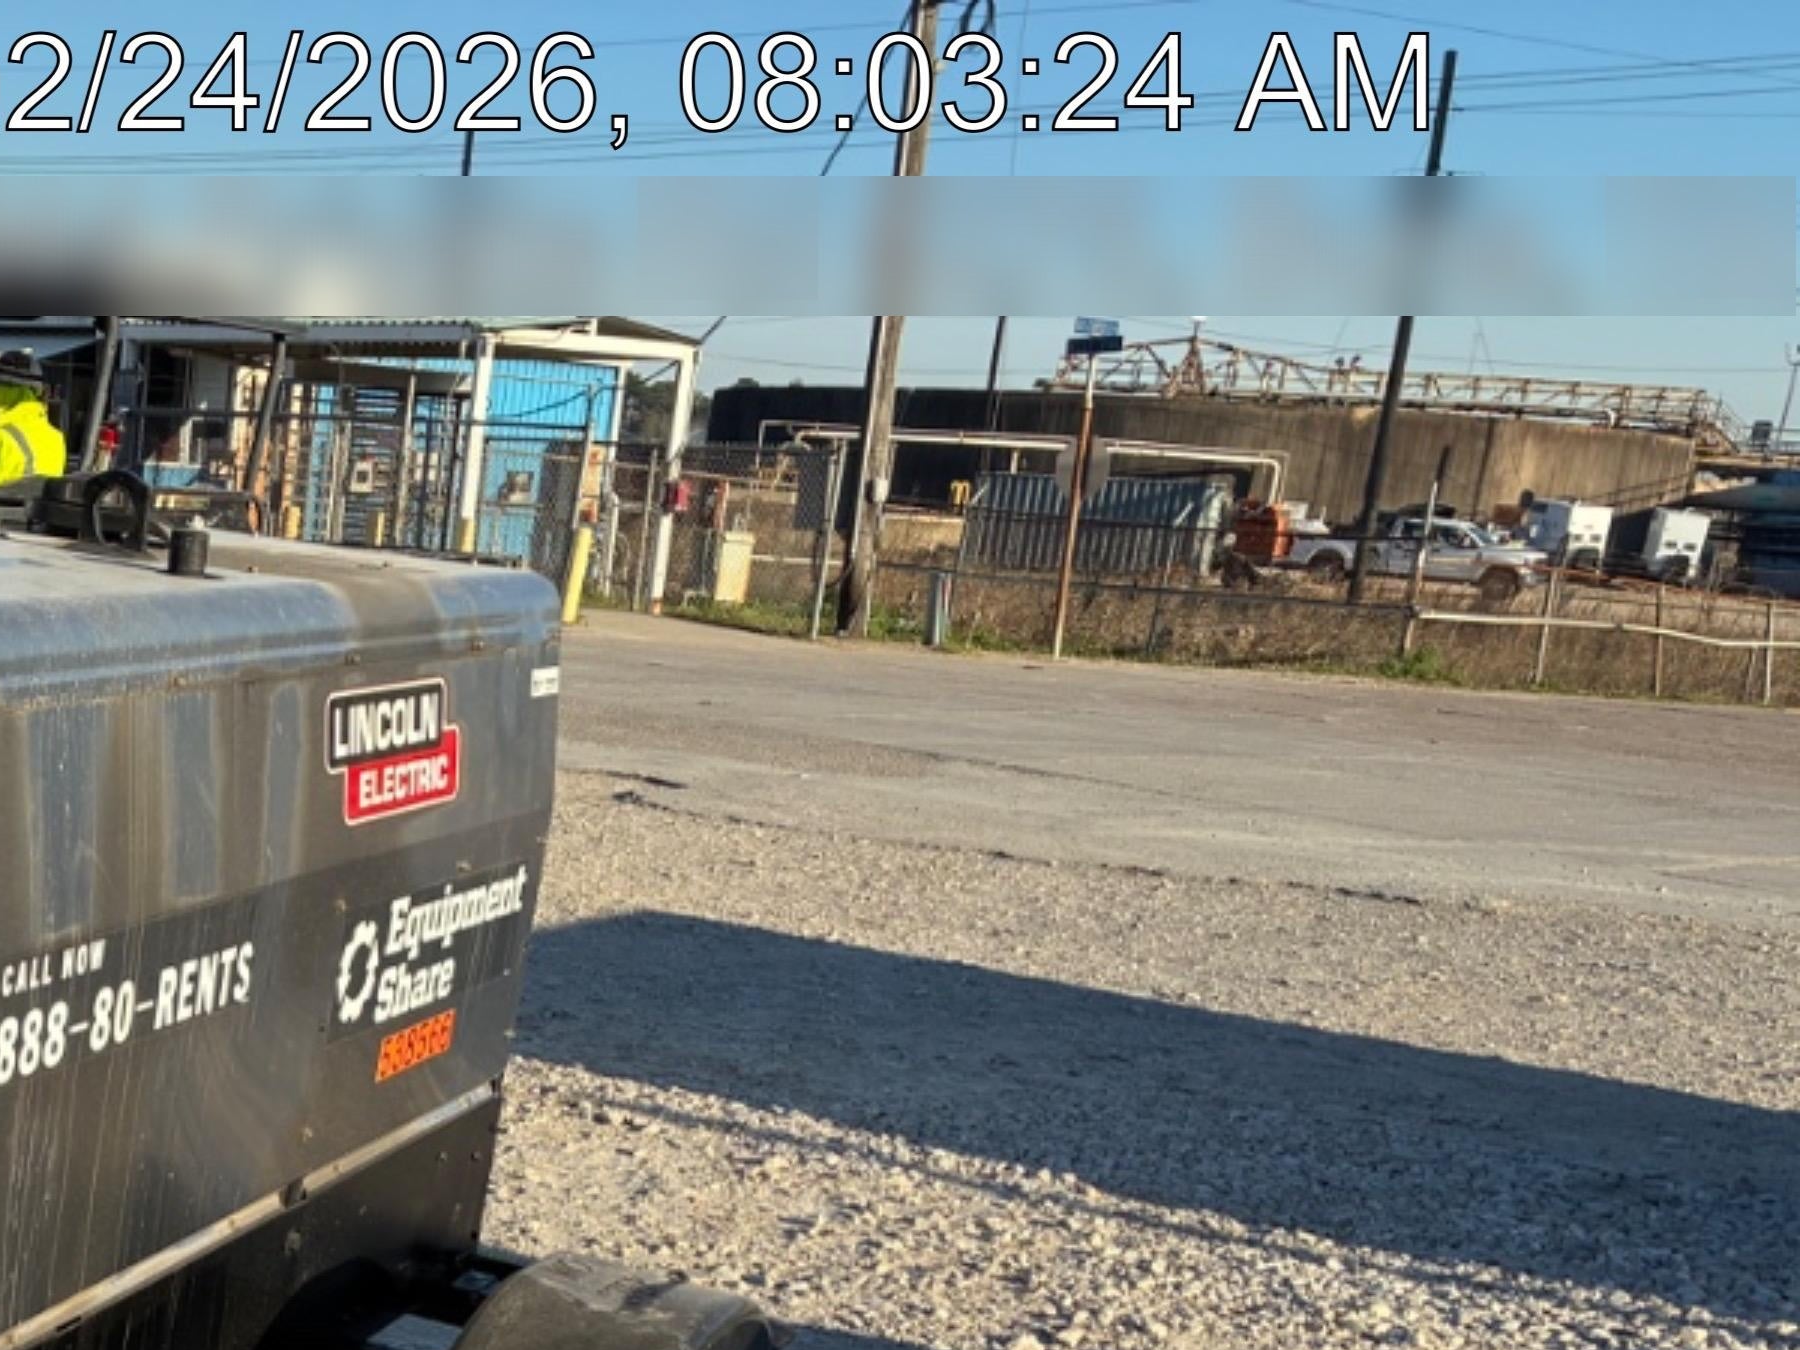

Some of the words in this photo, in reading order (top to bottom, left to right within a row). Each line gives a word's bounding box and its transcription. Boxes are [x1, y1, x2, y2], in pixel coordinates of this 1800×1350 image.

[334, 692, 439, 760] LINCOLN
[359, 752, 448, 809] ELECTRIC
[384, 865, 528, 960] Equipment
[1, 953, 51, 998] CALL
[61, 938, 106, 980] NOW
[374, 957, 455, 1025] Share
